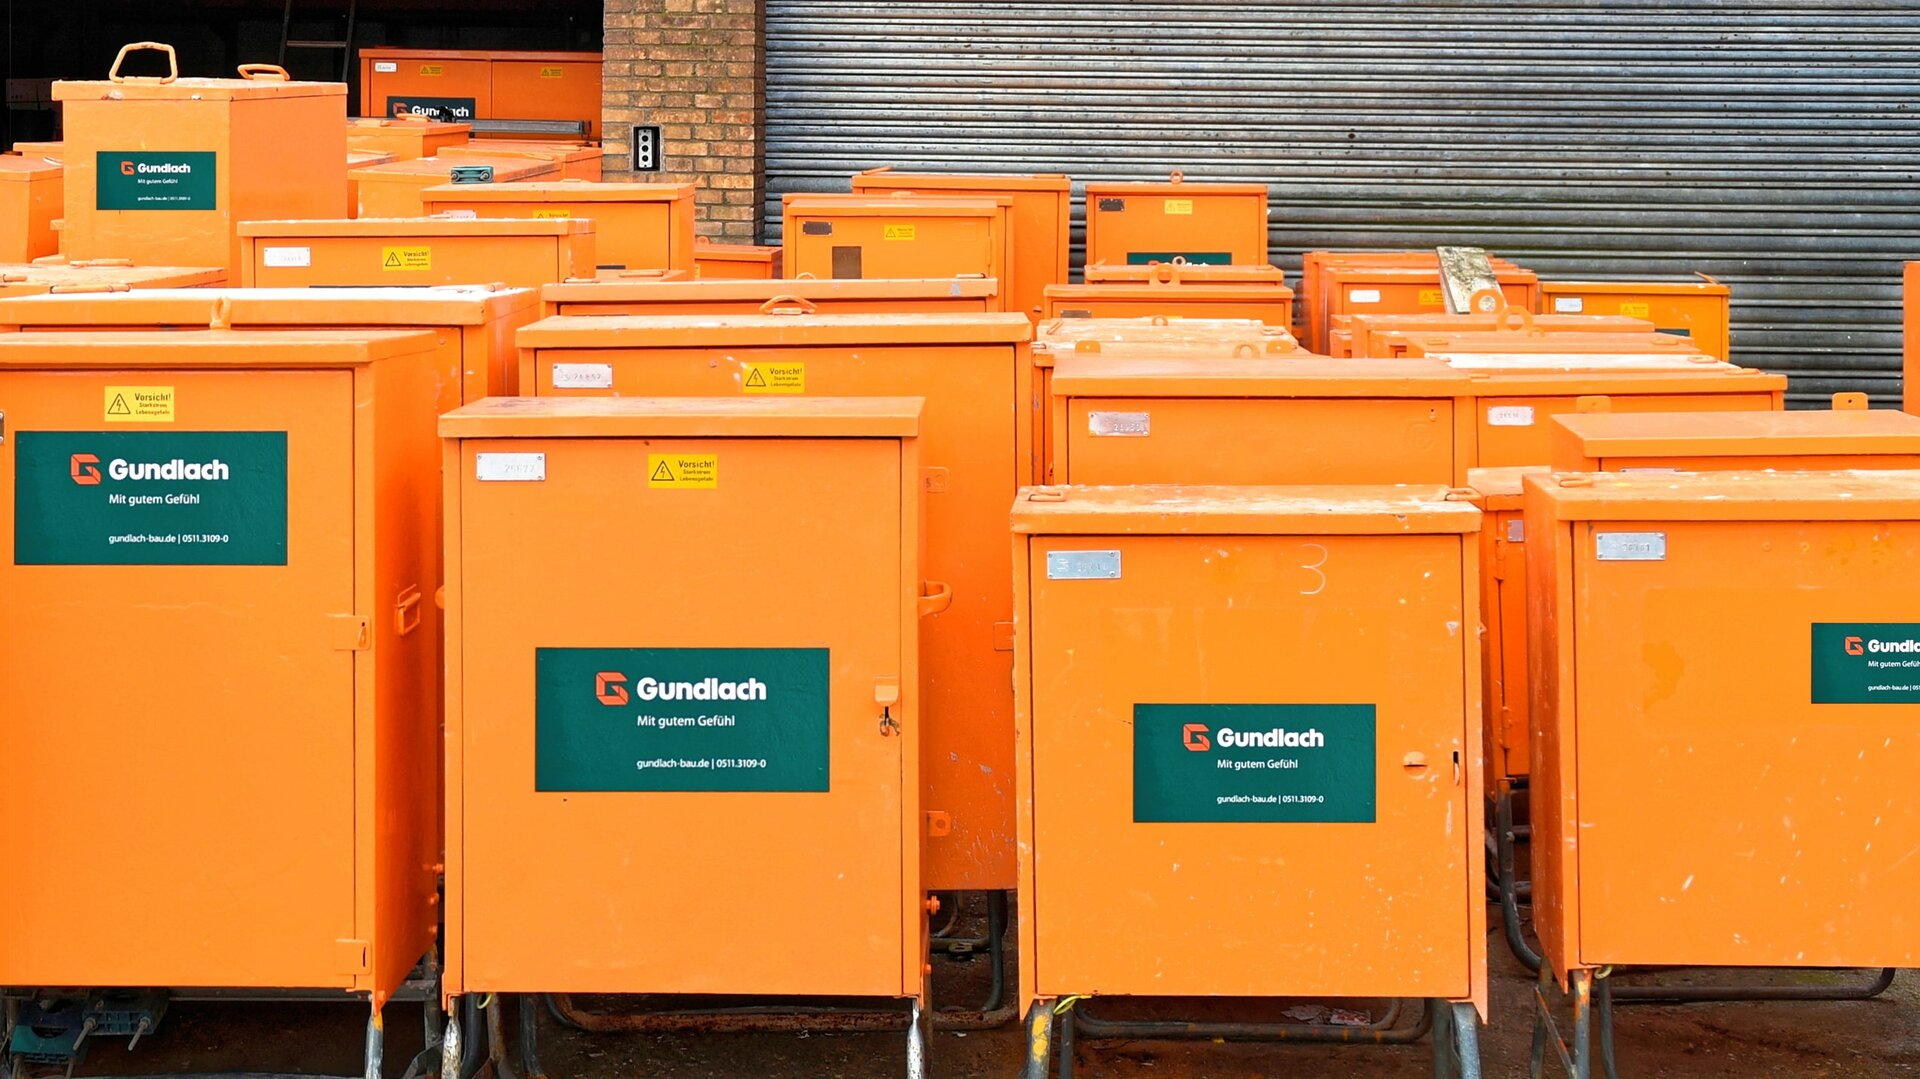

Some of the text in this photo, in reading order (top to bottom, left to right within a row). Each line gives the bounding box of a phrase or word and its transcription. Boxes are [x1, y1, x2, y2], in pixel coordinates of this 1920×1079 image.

[411, 105, 469, 118] Gunach
[137, 162, 191, 173] Gundlach
[769, 367, 803, 375] Vorsicht!
[134, 393, 171, 401] Vorsicht!
[108, 458, 230, 481] Gundlach
[678, 460, 715, 468] Vorsicht!
[108, 493, 200, 507] Mit gutem Gefühl
[108, 534, 177, 545] gundlach-bau.de
[182, 534, 229, 544] 0511.3109-0
[1300, 542, 1328, 595] 3
[1867, 660, 1880, 668] Mit
[1879, 660, 1902, 670] gutem
[636, 676, 767, 701] Gundlach
[636, 715, 736, 729] Mit gutem Gefühl
[1216, 727, 1325, 748] Gundlach
[636, 758, 710, 770] gundlach-bau.de
[716, 758, 767, 769] 0511.3109-0
[1217, 759, 1299, 771] Mit gutem Gefühl
[1216, 795, 1277, 805] gundlach-bau.de
[1282, 795, 1325, 804] 0511.3109-0
